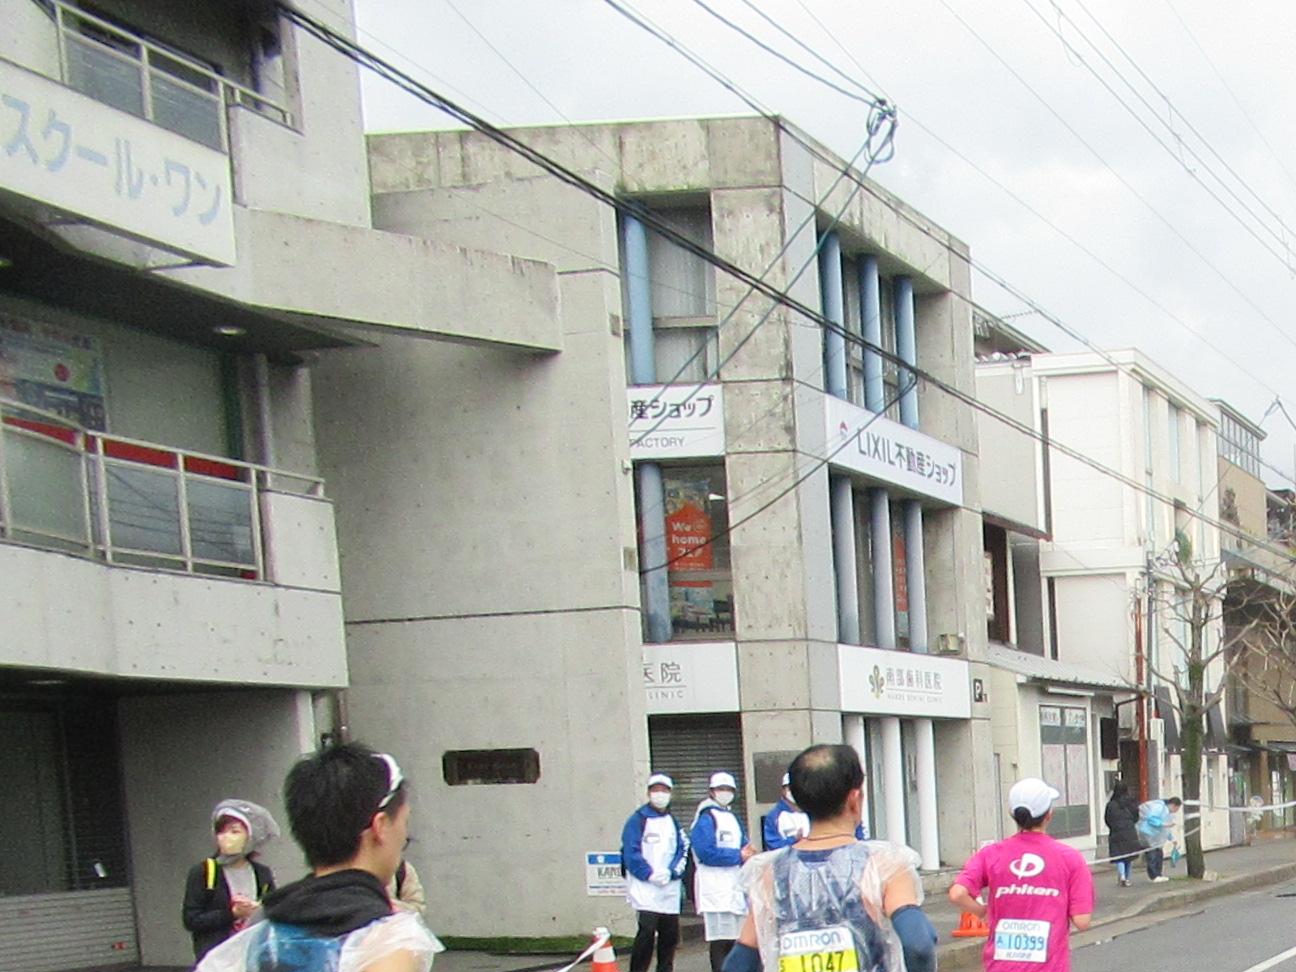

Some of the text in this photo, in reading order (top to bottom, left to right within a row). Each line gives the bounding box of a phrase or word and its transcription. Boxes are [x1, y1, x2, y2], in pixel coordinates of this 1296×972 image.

[1, 94, 222, 225] スクール・ワン
[1008, 935, 1045, 950] 10399
